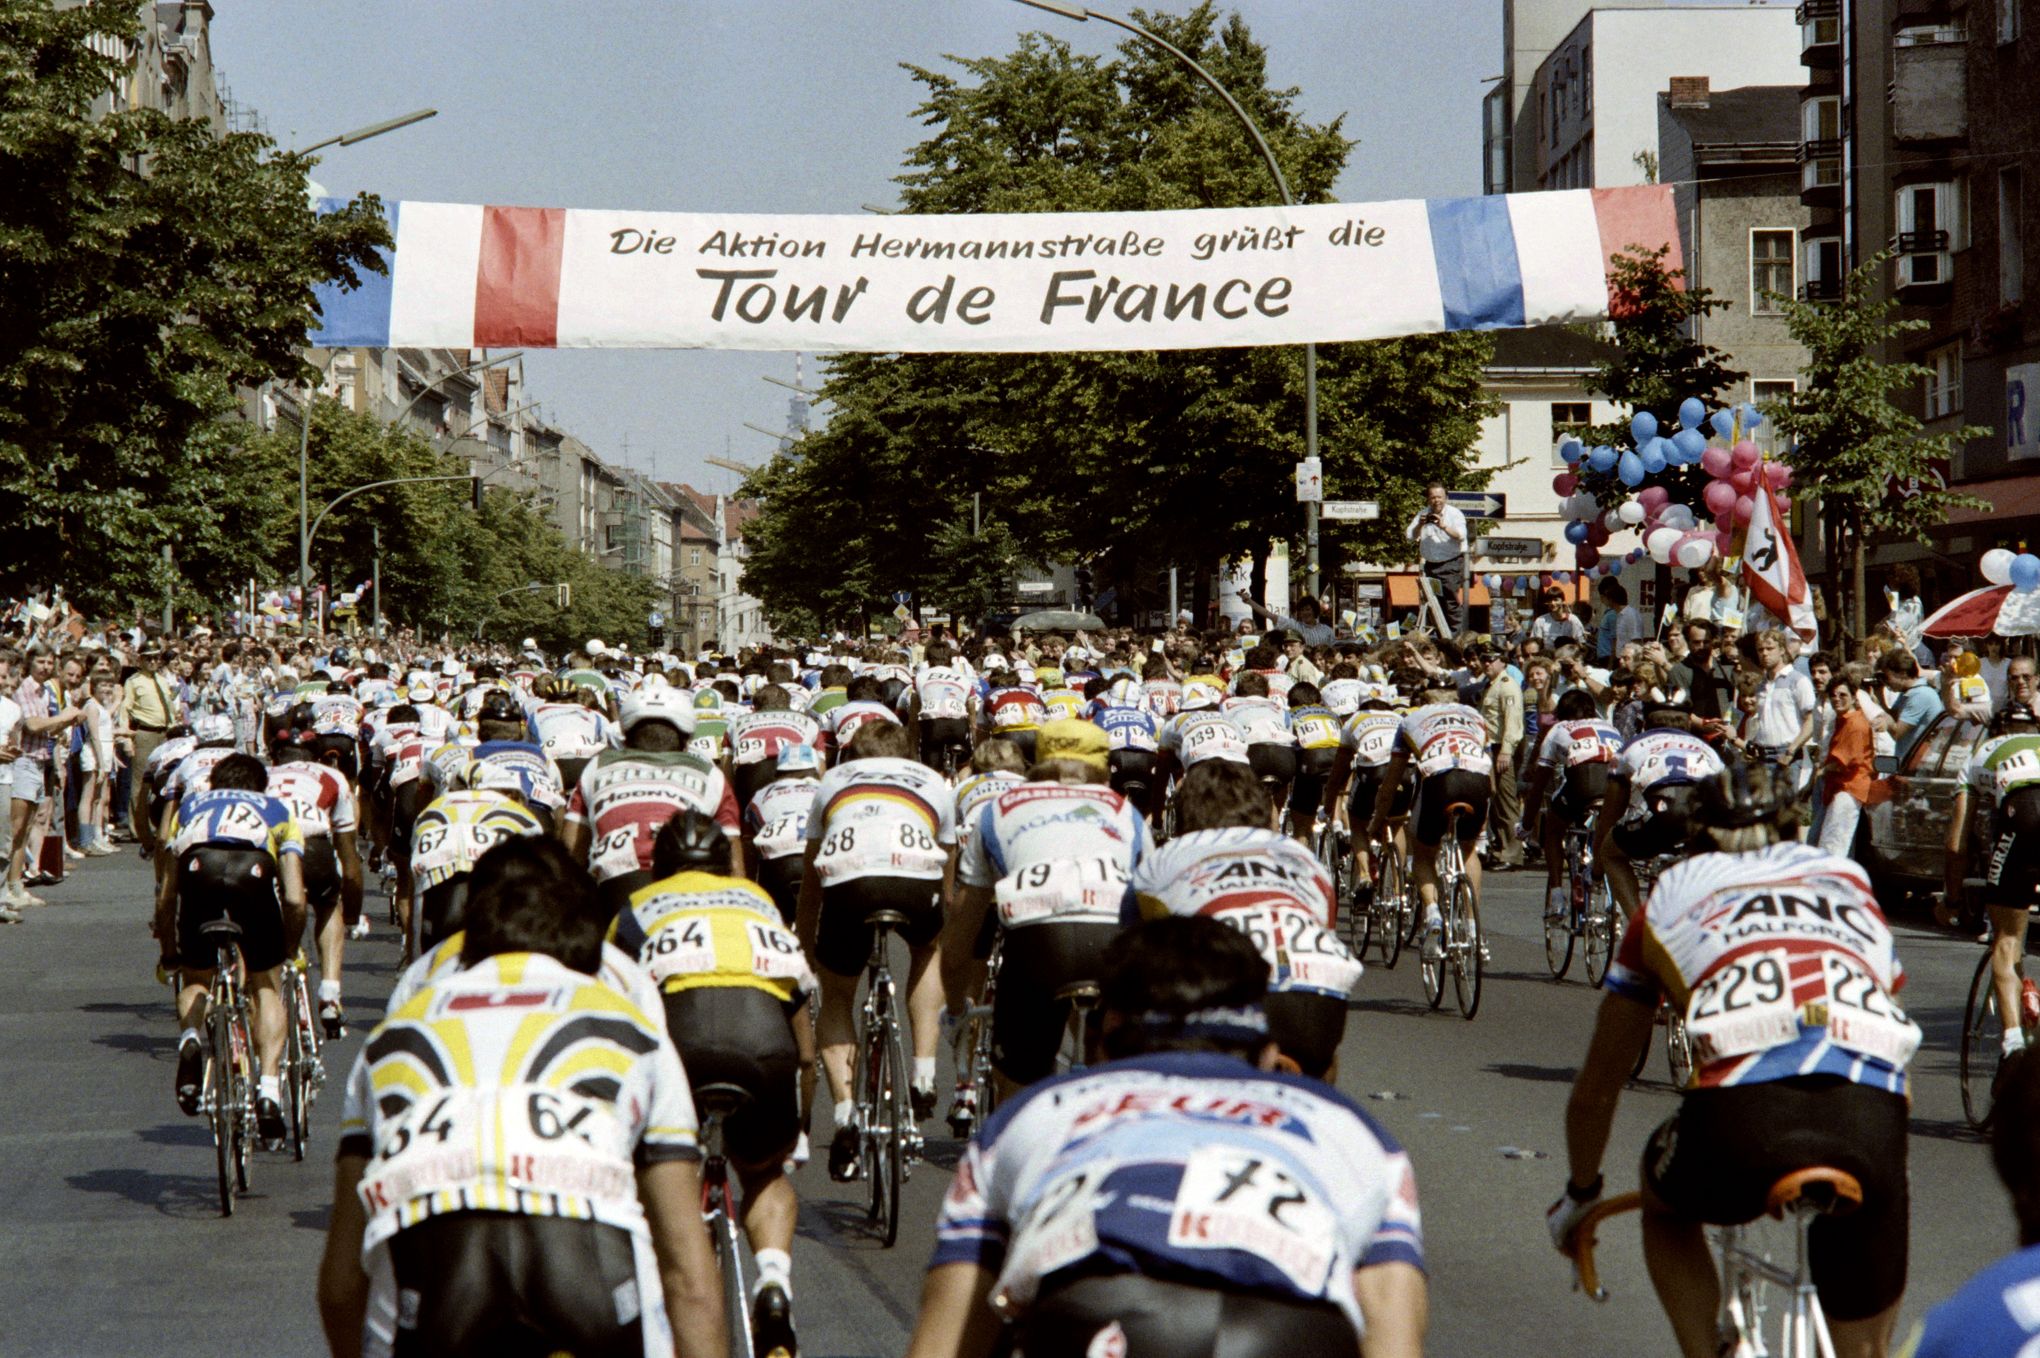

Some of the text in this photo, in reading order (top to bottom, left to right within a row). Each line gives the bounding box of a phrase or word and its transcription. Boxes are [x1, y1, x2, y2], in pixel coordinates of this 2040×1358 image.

[610, 219, 1386, 262] Die Aktion Hermannstraße grüßt die
[696, 268, 1293, 326] Tour de France
[1487, 540, 1528, 554] Kopfstraße
[419, 828, 448, 854] 67
[1016, 864, 1050, 890] 19
[1730, 894, 1877, 944] ANC
[646, 921, 704, 963] 164
